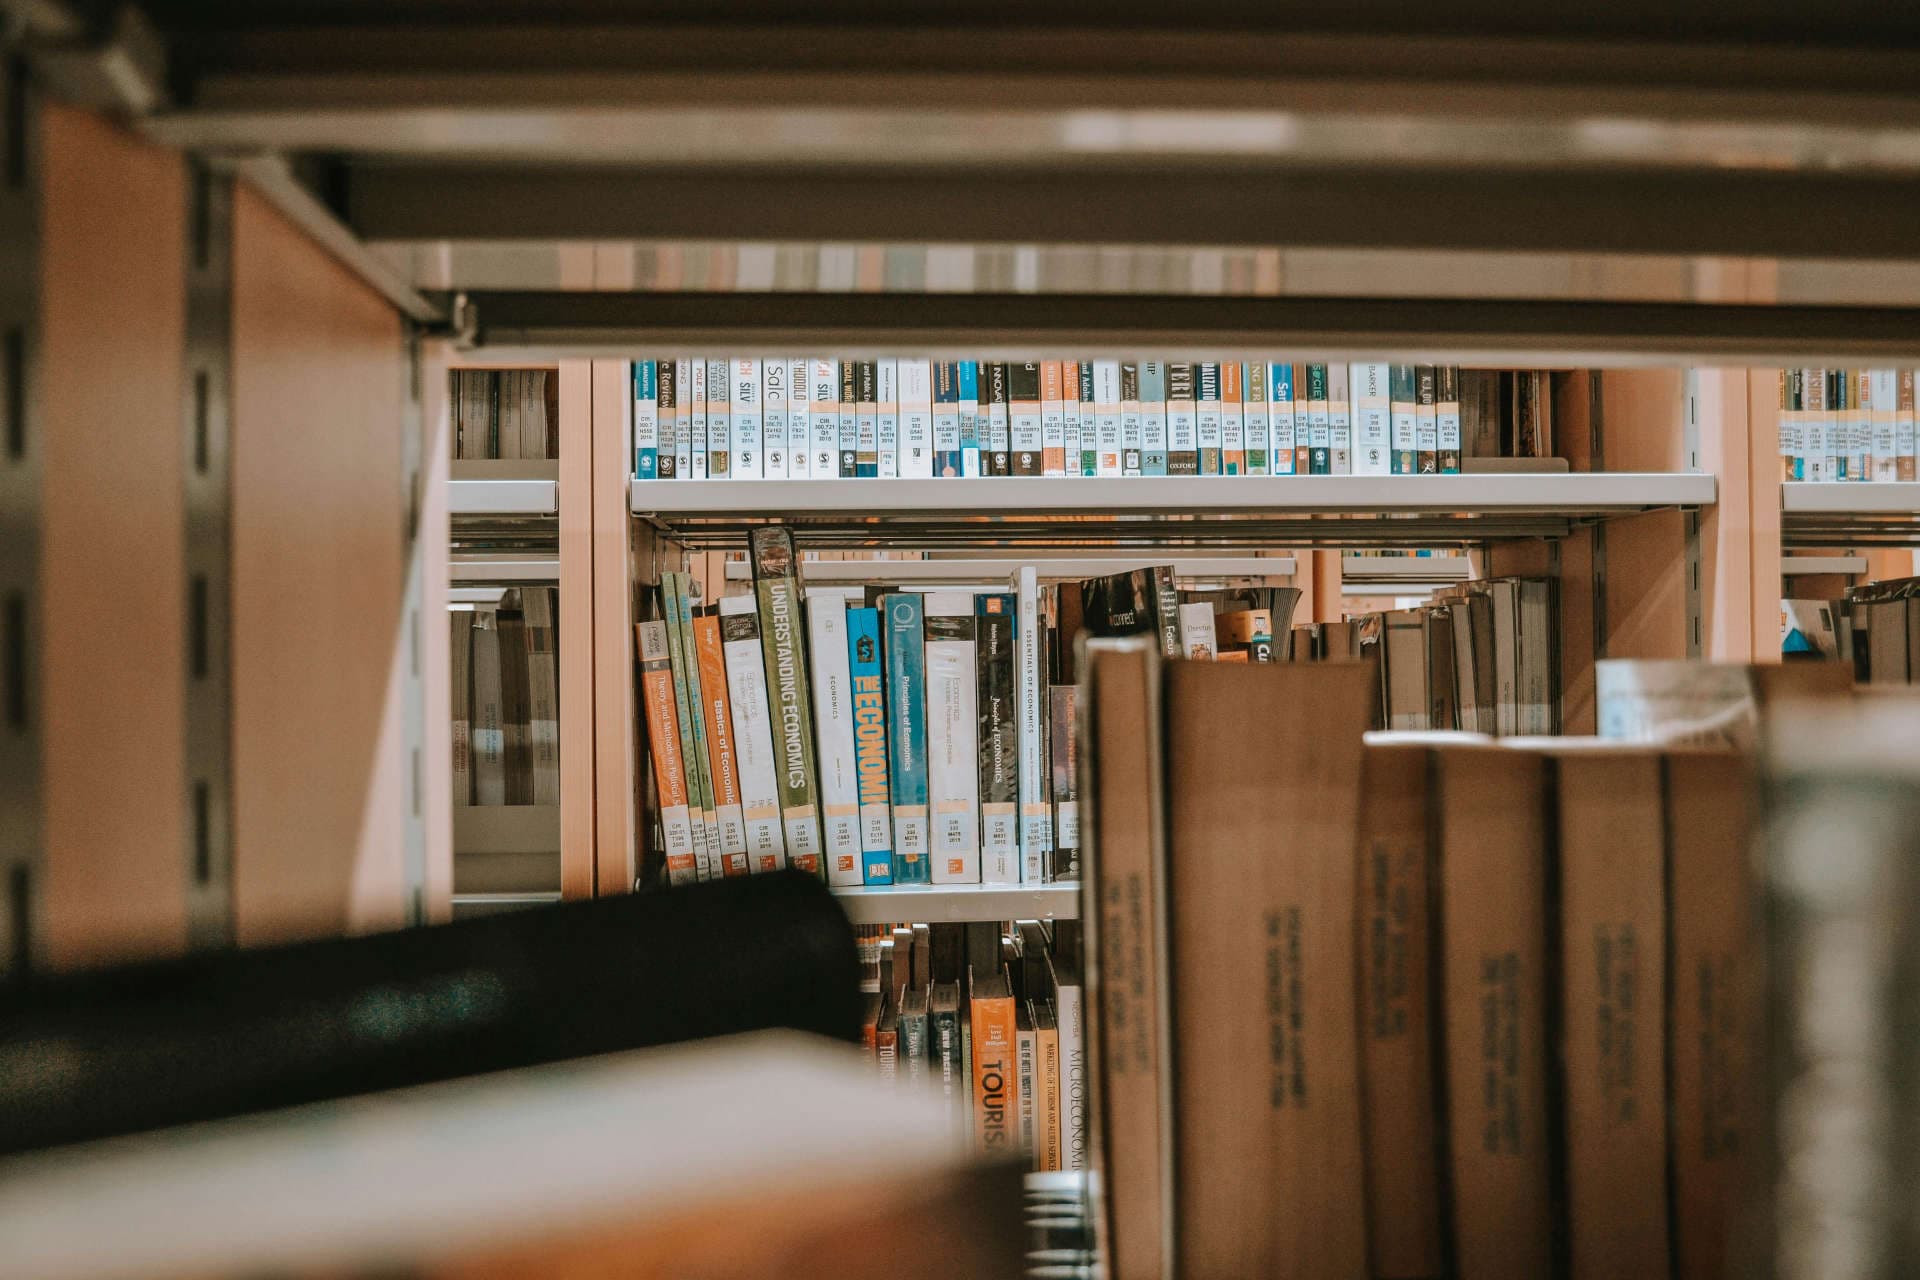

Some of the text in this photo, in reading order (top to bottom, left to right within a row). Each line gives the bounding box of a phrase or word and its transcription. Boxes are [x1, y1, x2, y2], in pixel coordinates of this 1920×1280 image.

[661, 373, 672, 408] Review
[1368, 365, 1377, 397] BARKER
[1166, 625, 1175, 655] Focus
[657, 676, 666, 702] Theory
[770, 584, 791, 701] UNDERSTANDING
[782, 705, 805, 789] ECONOMICS
[854, 675, 882, 692] THE
[1026, 676, 1033, 687] OF
[661, 704, 670, 720] and
[829, 675, 839, 720] ECONOMICS
[714, 701, 725, 736] Basics
[901, 676, 912, 772] Principles of Economics
[663, 722, 674, 754] Methods
[719, 738, 729, 750] of
[990, 695, 1002, 785] Principles of ECONOMICS
[669, 767, 681, 798] Political
[1071, 1001, 1080, 1039] NECHYBA
[908, 1032, 918, 1057] TRAVEL
[942, 1030, 951, 1082] NEW FACETS
[1021, 1059, 1032, 1073] HOTEL
[1046, 1043, 1056, 1078] MARKETING
[1021, 1074, 1032, 1099] INDUSTRY
[1047, 1086, 1057, 1112] TOURISM
[1047, 1112, 1057, 1125] AND
[1047, 1125, 1057, 1144] ALLIED
[1047, 1145, 1057, 1172] SERVICES
